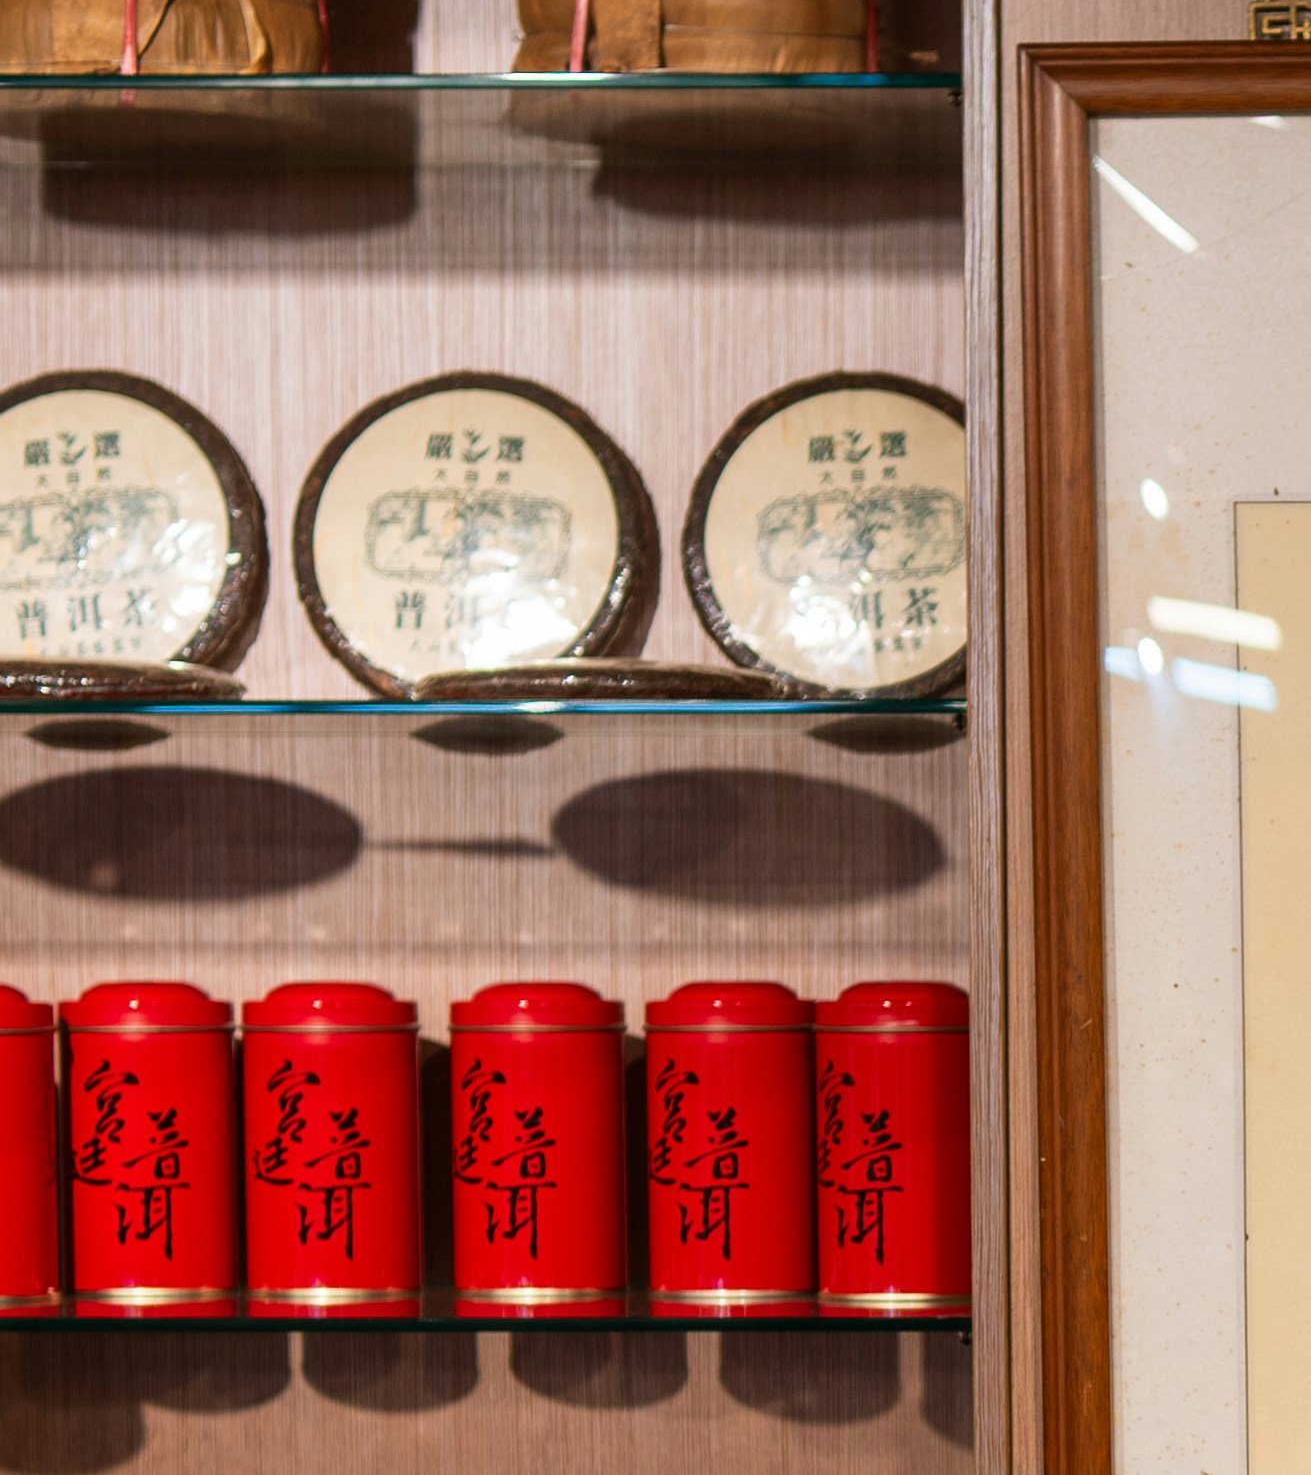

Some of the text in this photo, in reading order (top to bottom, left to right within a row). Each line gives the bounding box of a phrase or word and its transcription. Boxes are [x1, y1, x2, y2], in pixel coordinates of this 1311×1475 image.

[17, 588, 156, 639] 普洱茶
[113, 1107, 191, 1261] 普洱
[253, 1058, 321, 1186] 宮廷
[293, 1107, 372, 1261] 普洱
[482, 1106, 557, 1261] 普洱
[678, 1106, 750, 1262] 普洱
[836, 1107, 904, 1265] 普洱
